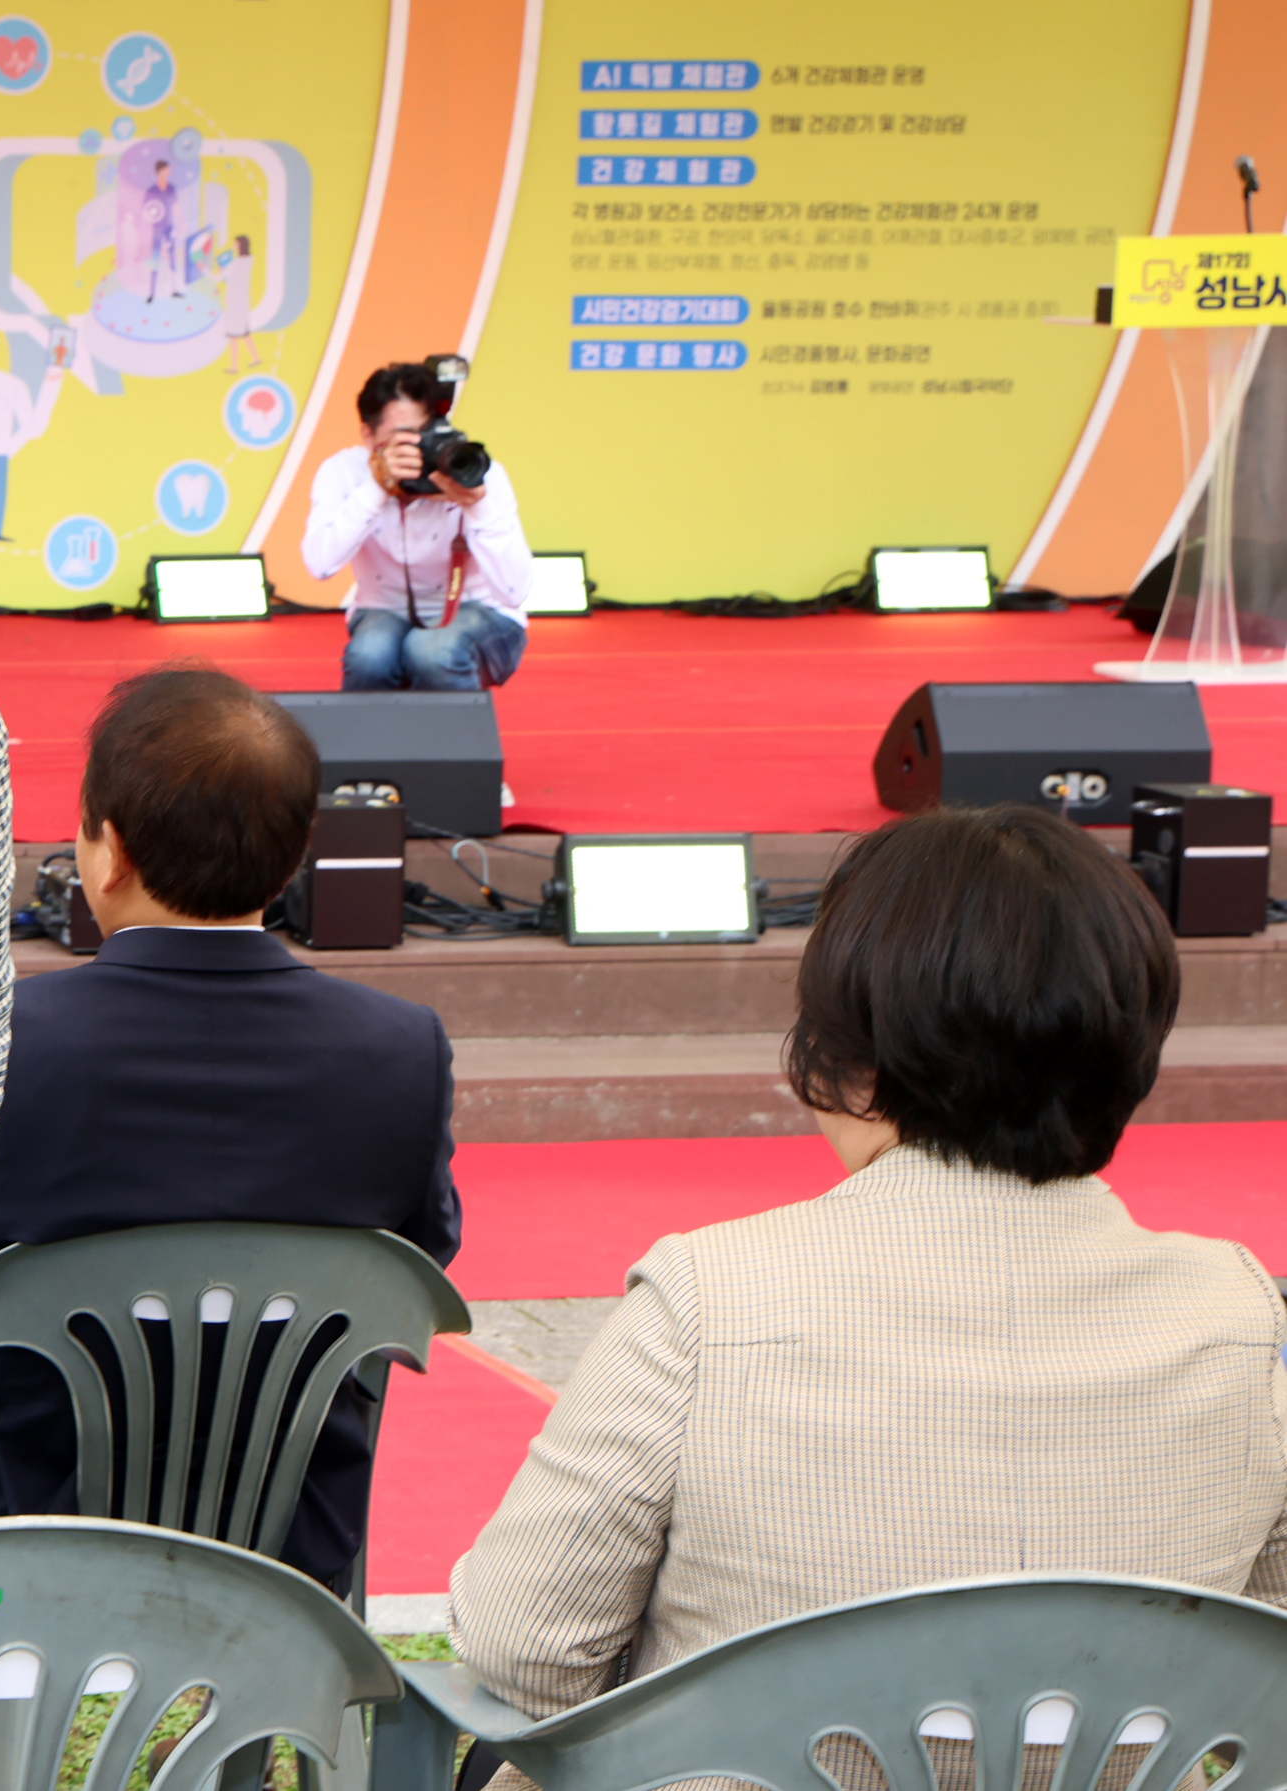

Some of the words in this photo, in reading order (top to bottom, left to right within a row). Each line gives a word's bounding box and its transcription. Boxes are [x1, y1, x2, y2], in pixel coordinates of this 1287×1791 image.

[593, 63, 621, 88] AI
[629, 63, 673, 88] 특별
[681, 63, 748, 88] 체험관
[770, 65, 801, 86] 6개
[805, 65, 888, 87] 건강체험관
[892, 65, 926, 87] 운영
[675, 111, 745, 137] 체험관
[769, 114, 804, 135] 맨발
[808, 114, 875, 136] 건강걷기
[879, 114, 895, 133] 및
[899, 114, 968, 136] 건강상담
[572, 202, 589, 220] 각
[593, 202, 643, 222] 병원과
[648, 202, 696, 222] 보건소
[806, 202, 872, 222] 상담하는
[876, 202, 960, 222] 건강체험관
[962, 202, 1002, 222] 24개
[1006, 201, 1040, 222] 운영
[1197, 253, 1251, 270] 제17회
[580, 298, 741, 323] 시민건강걷기대회
[832, 299, 864, 321] 호수
[580, 342, 626, 368] 건강
[637, 342, 682, 368] 문화
[693, 342, 739, 368] 행사
[865, 344, 933, 365] 문화공연
